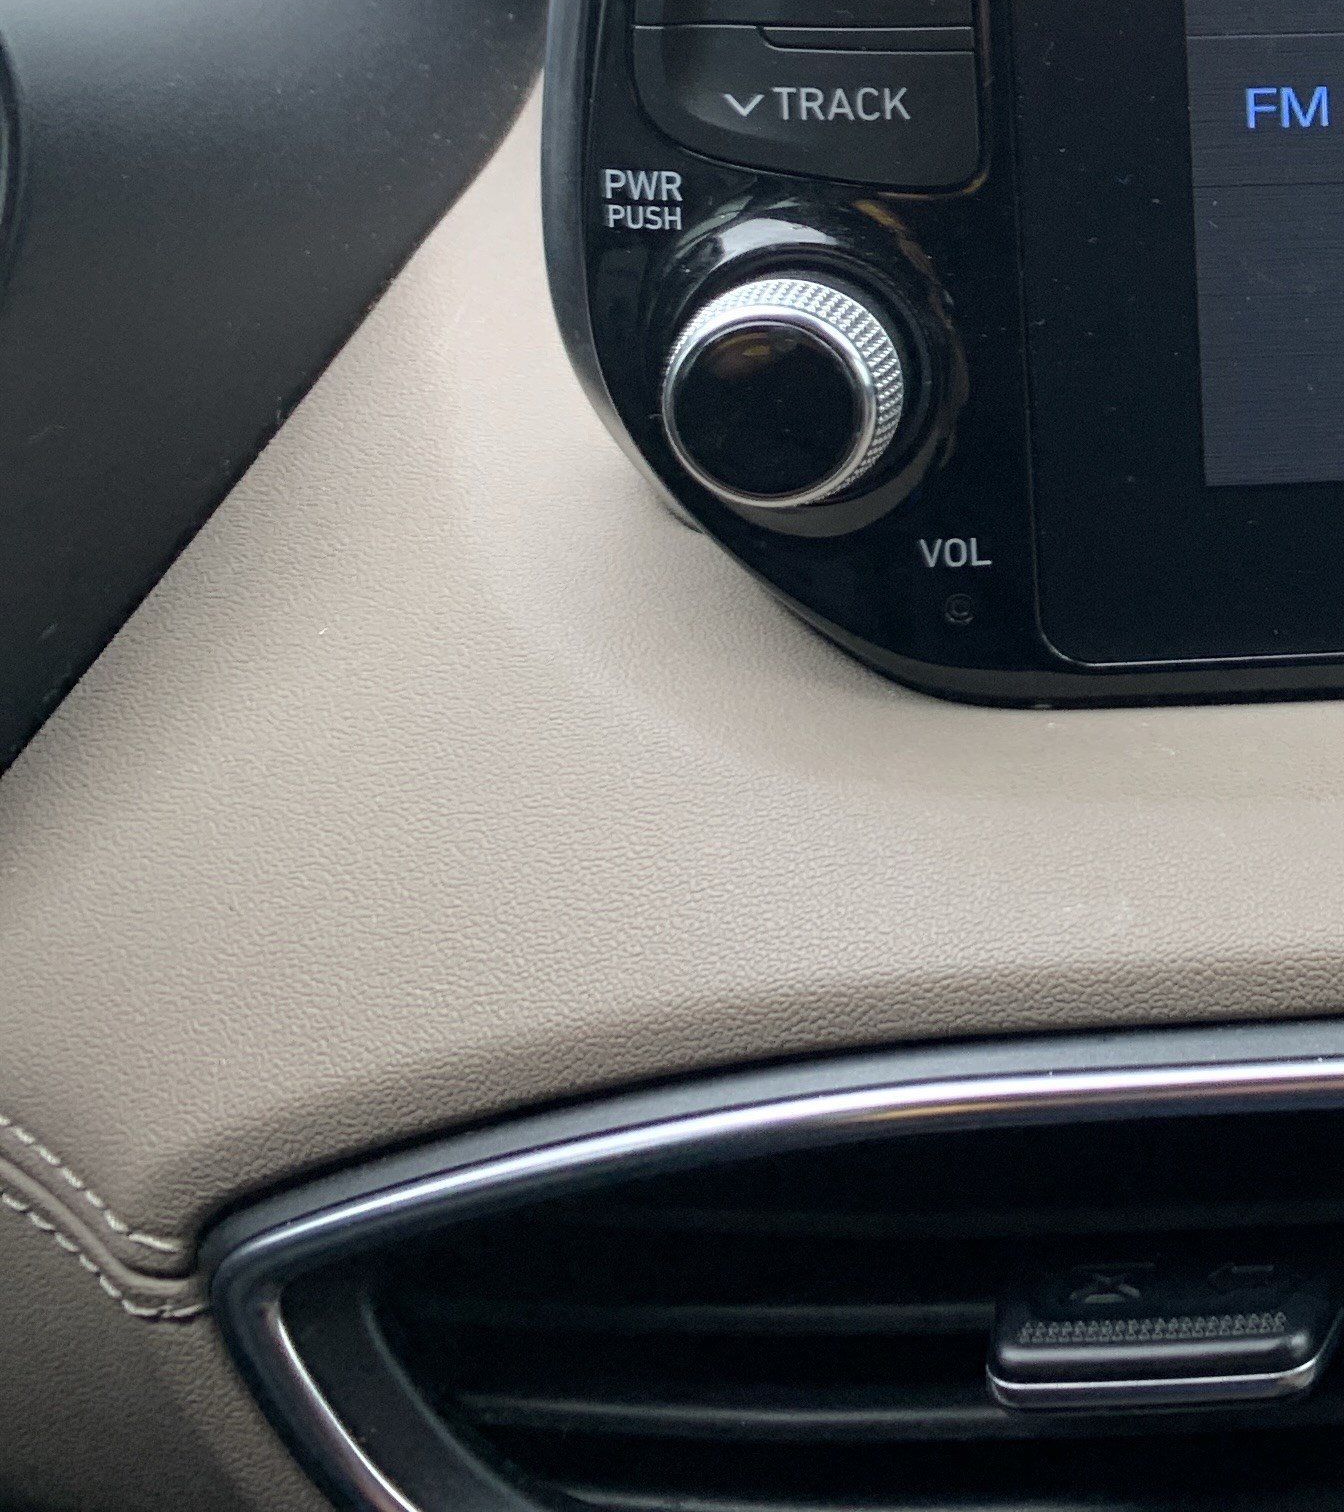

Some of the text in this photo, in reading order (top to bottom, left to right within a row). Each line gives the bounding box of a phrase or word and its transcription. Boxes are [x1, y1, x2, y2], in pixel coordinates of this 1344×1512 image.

[771, 86, 911, 121] TRACK
[1246, 86, 1329, 129] FM
[604, 168, 683, 202] PWR
[607, 204, 682, 230] PUSH
[919, 537, 993, 568] VOL
